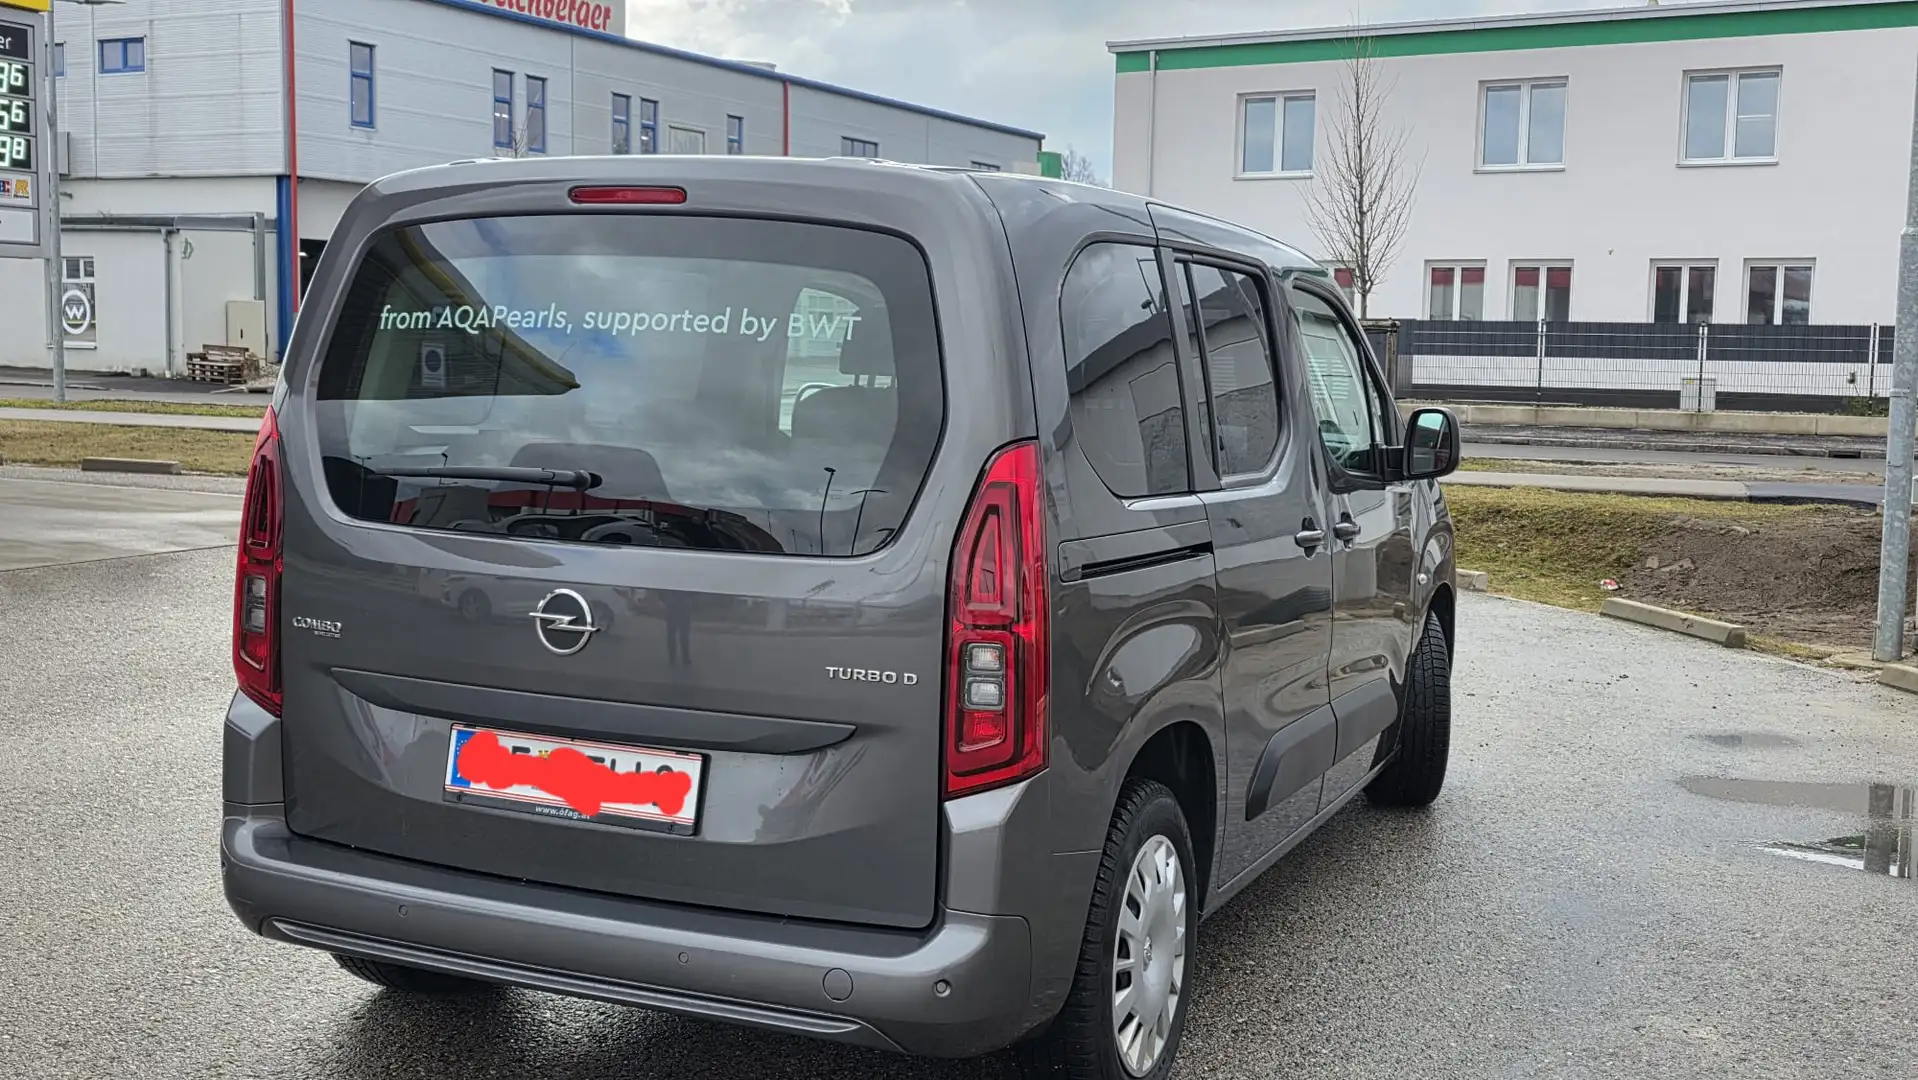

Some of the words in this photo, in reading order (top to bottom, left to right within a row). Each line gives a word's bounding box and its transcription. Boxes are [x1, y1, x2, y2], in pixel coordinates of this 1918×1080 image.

[380, 305, 431, 330] from
[437, 302, 573, 335] AQAPearls,
[583, 307, 731, 336] supported
[740, 308, 778, 342] by
[787, 313, 862, 341] BWT
[292, 616, 342, 633] COMBO
[825, 666, 897, 684] TURBO
[903, 672, 918, 685] D
